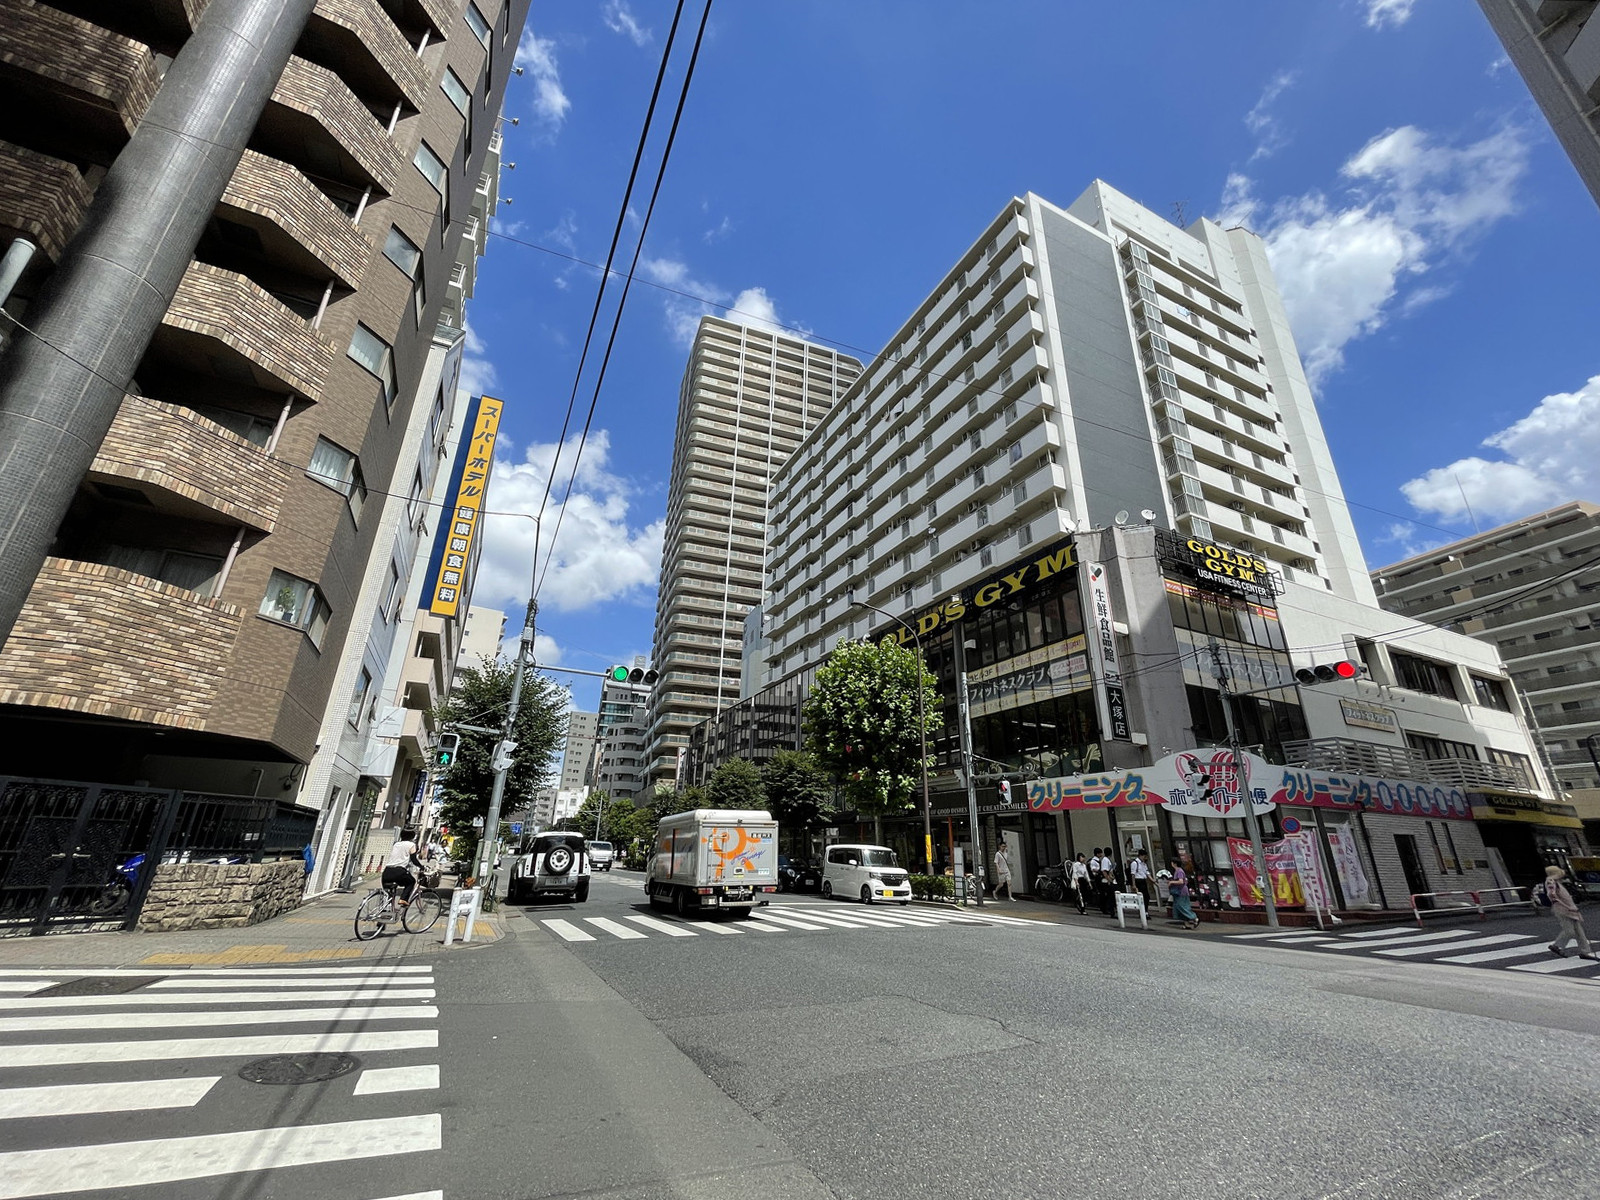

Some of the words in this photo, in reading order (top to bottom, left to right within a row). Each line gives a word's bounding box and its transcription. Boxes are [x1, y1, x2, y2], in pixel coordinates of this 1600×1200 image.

[460, 405, 499, 498] スーパーホテル
[438, 505, 475, 603] 健康朝食無料
[1187, 539, 1267, 574] GOLD'S
[1205, 558, 1257, 584] GYM
[880, 597, 966, 649] OLD'S
[974, 543, 1079, 607] GYM
[1197, 568, 1214, 580] USA
[1214, 574, 1242, 590] FITNESS
[1241, 581, 1268, 597] CENTER
[1094, 588, 1116, 664] 生鮮食品館
[1109, 690, 1127, 736] 大塚店
[1007, 802, 1028, 810] SMILES
[1029, 773, 1147, 809] クリーニング
[1282, 770, 1375, 809] クリーニング
